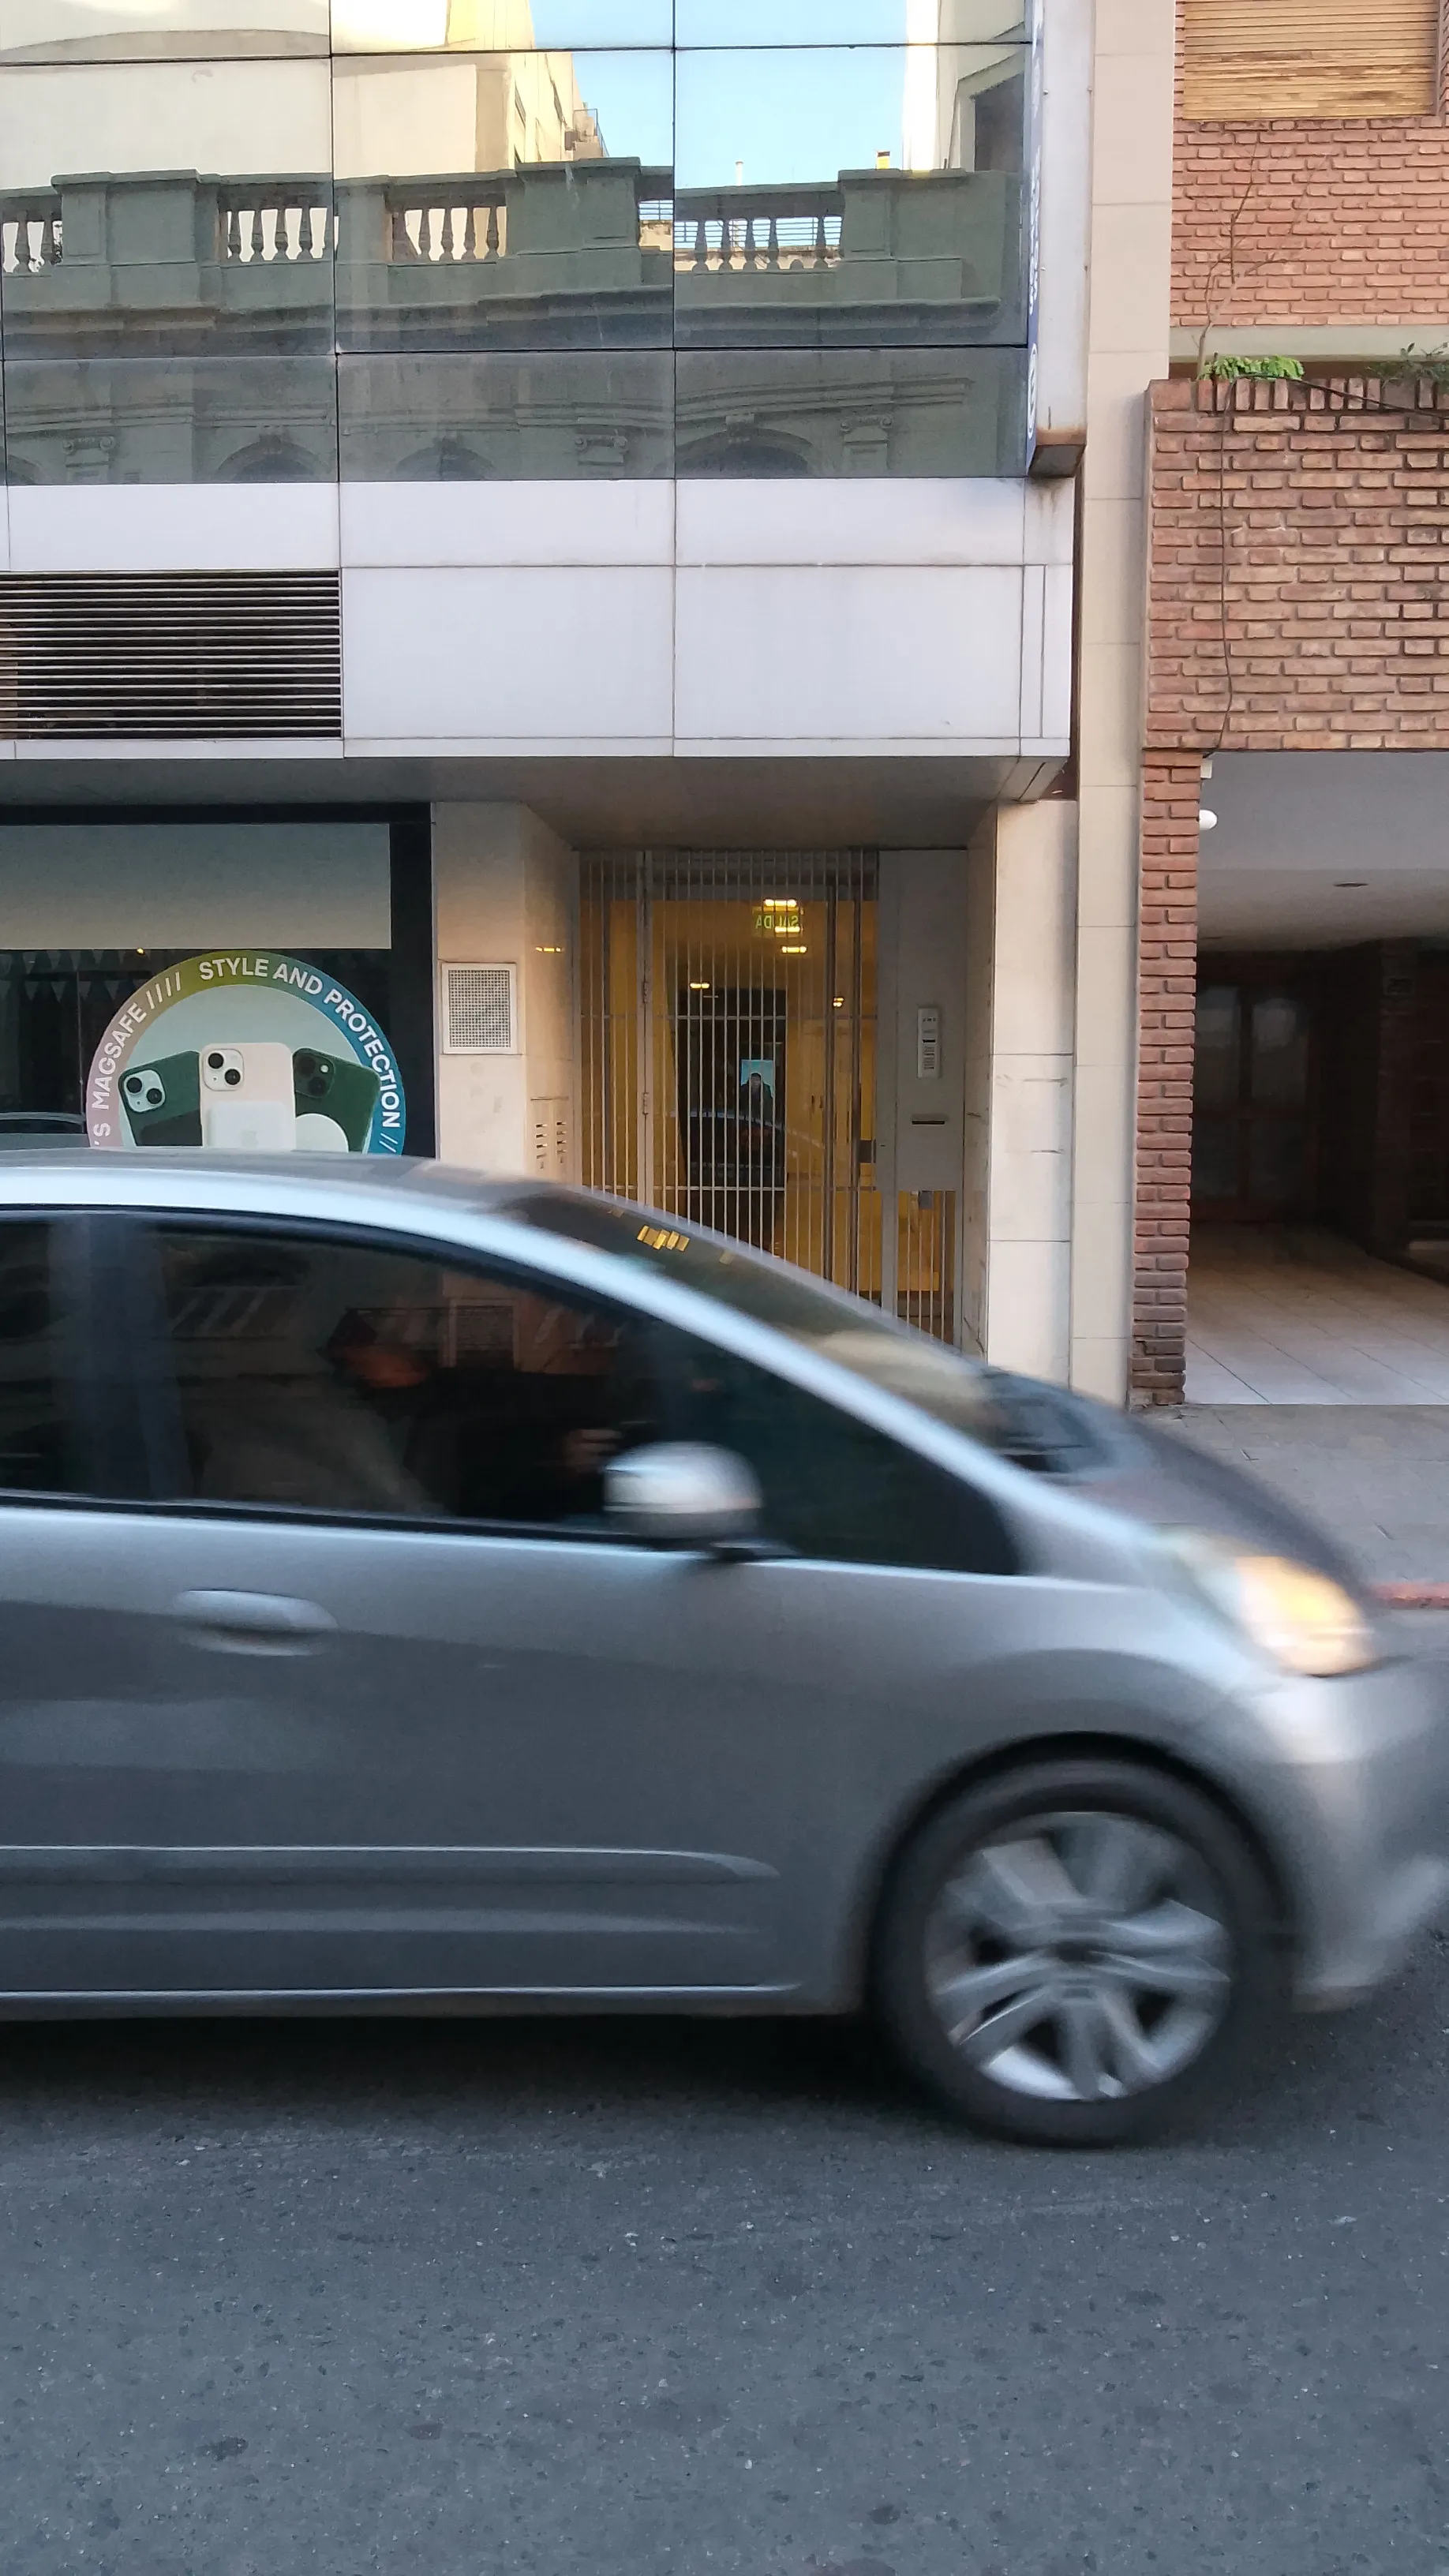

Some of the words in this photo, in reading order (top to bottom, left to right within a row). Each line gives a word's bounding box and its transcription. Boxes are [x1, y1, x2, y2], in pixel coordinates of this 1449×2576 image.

[92, 1002, 148, 1110] MAGSAFE
[199, 957, 270, 981] STYLE
[272, 962, 324, 995] AND
[323, 988, 402, 1129] PROTECTION
